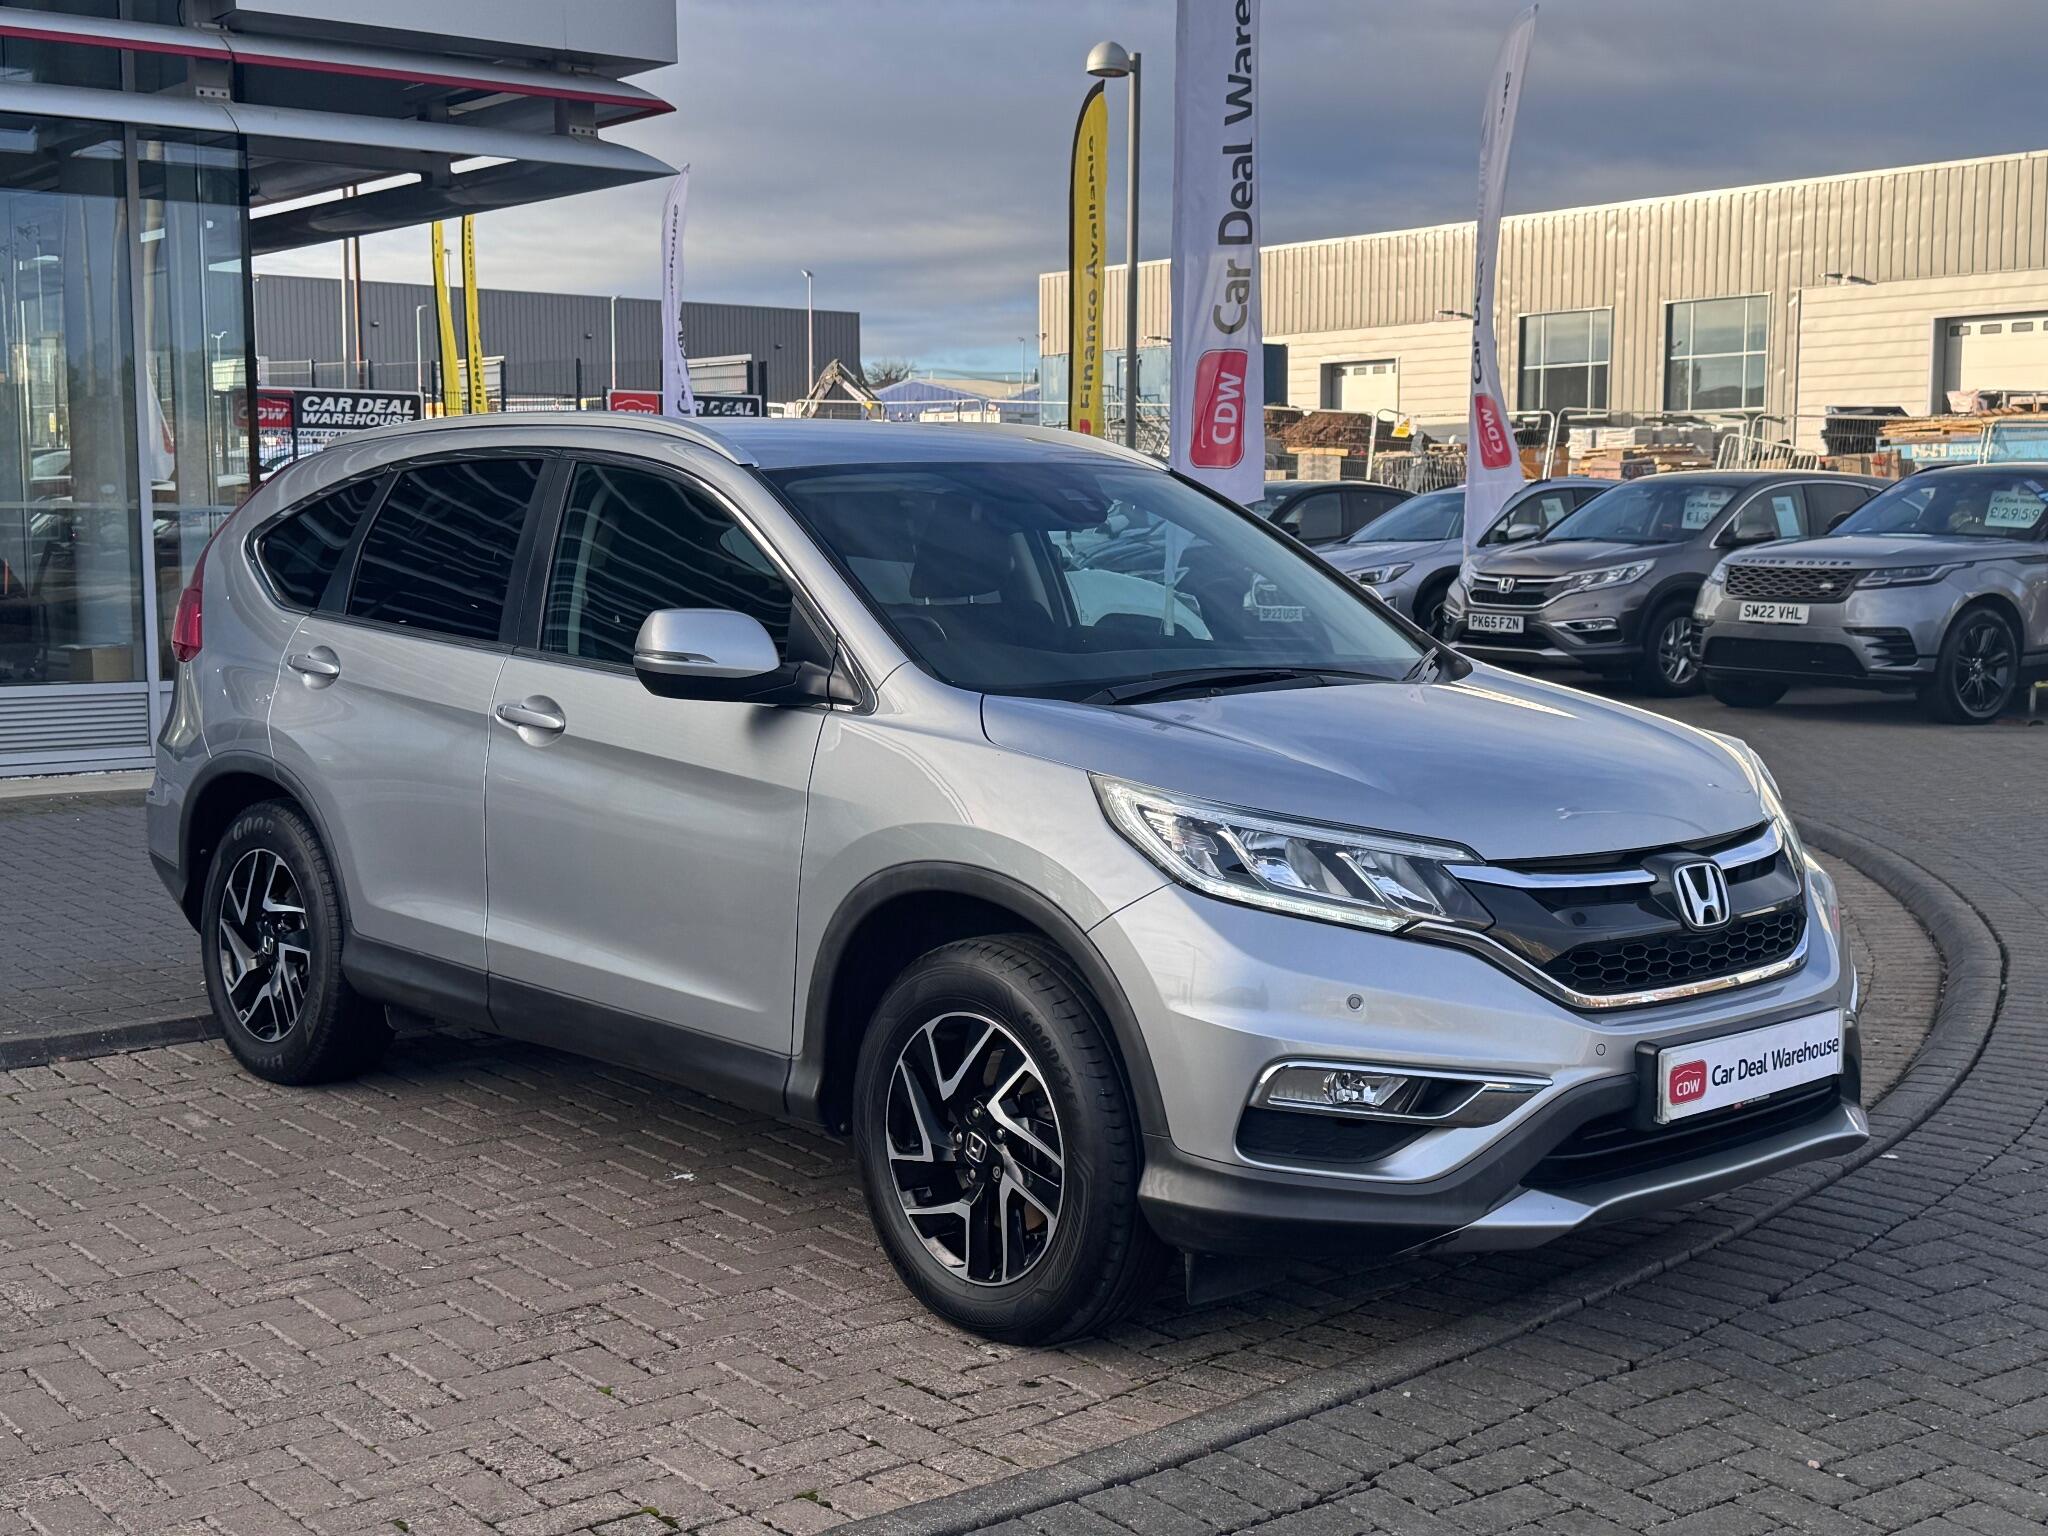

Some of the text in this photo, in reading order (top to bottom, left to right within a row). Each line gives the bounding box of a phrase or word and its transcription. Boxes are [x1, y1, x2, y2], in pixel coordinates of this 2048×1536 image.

[1217, 137, 1253, 245] Deal
[1213, 259, 1251, 334] Car
[302, 396, 415, 414] CAR DEAL
[302, 412, 414, 426] WAREHOUSE
[1212, 371, 1242, 446] CDW
[281, 429, 327, 438] CHAPEST
[1480, 408, 1504, 453] CDW
[1472, 615, 1520, 630] PK65 FZN
[1778, 606, 1802, 620] VHL
[1676, 1036, 1839, 1097] CDW Car Deal Warehouse
